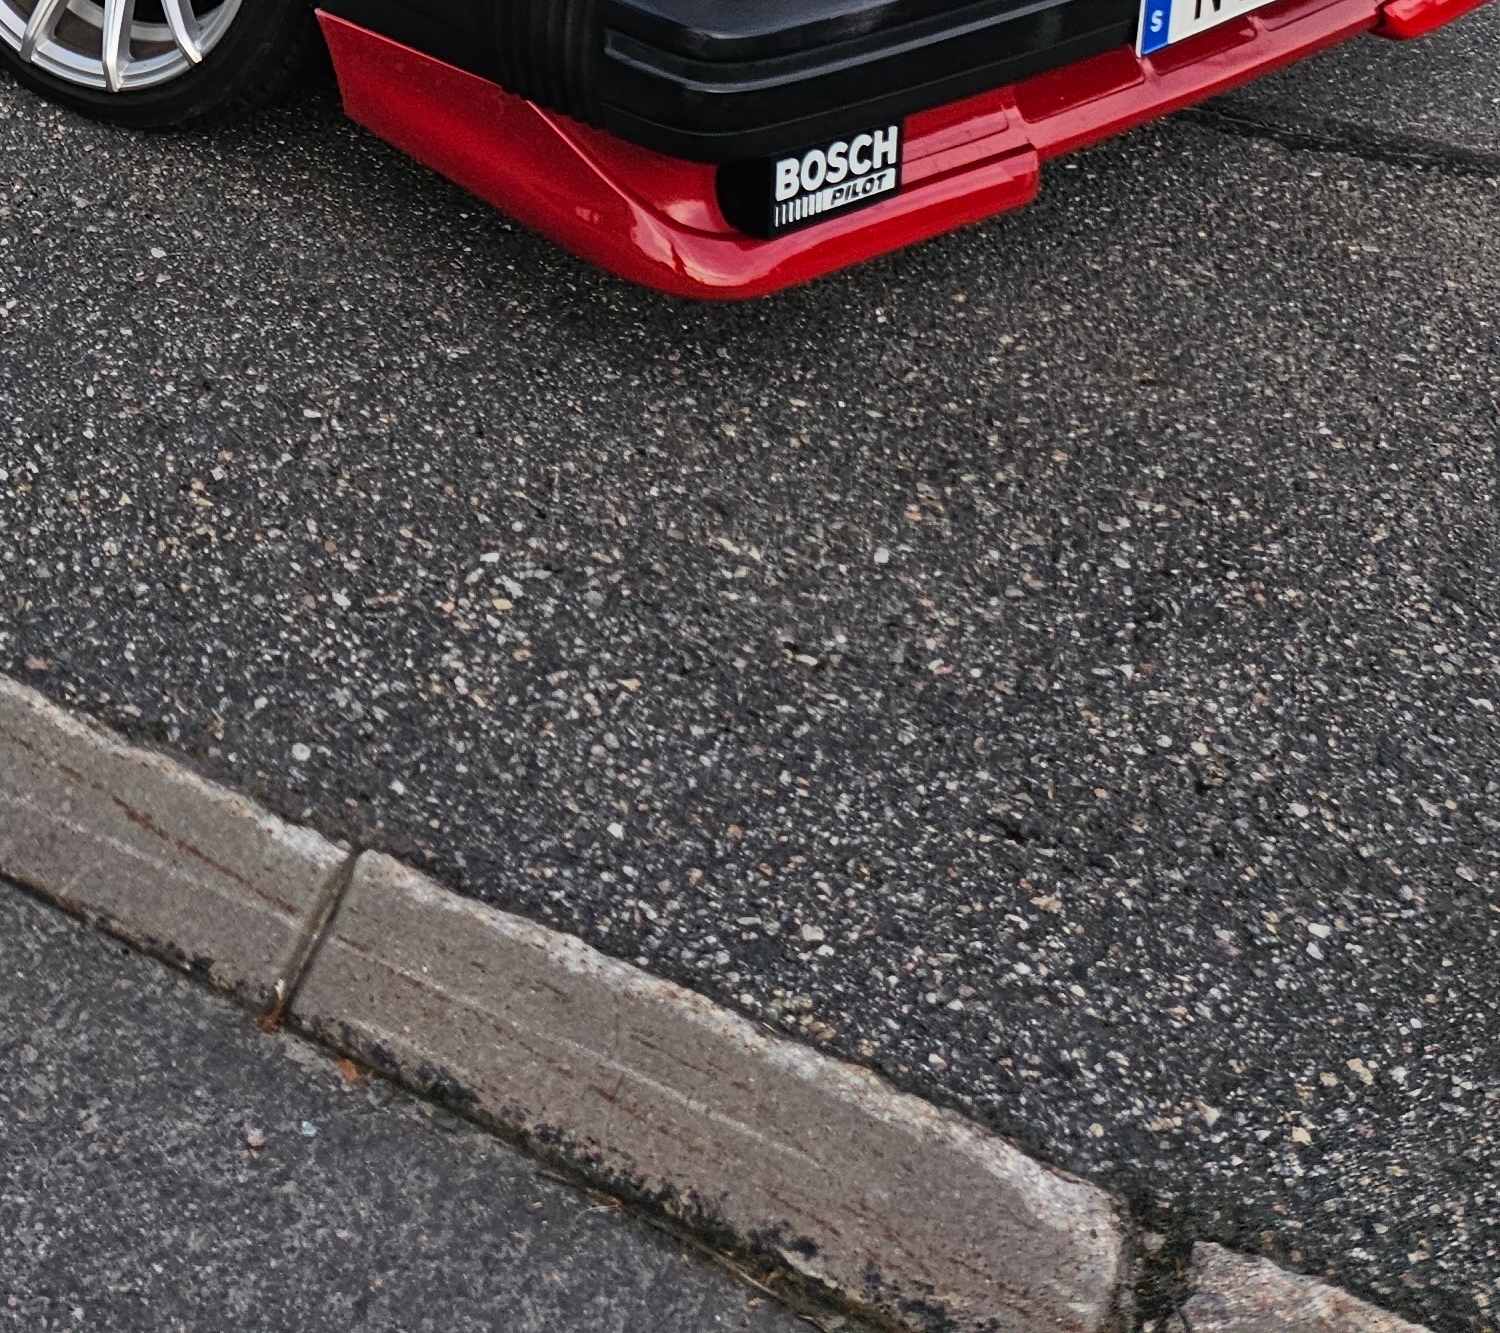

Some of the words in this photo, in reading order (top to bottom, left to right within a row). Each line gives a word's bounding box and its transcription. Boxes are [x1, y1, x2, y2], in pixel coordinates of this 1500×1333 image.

[1150, 9, 1163, 32] S
[775, 125, 899, 202] BOSCH
[830, 172, 888, 206] PILOT
